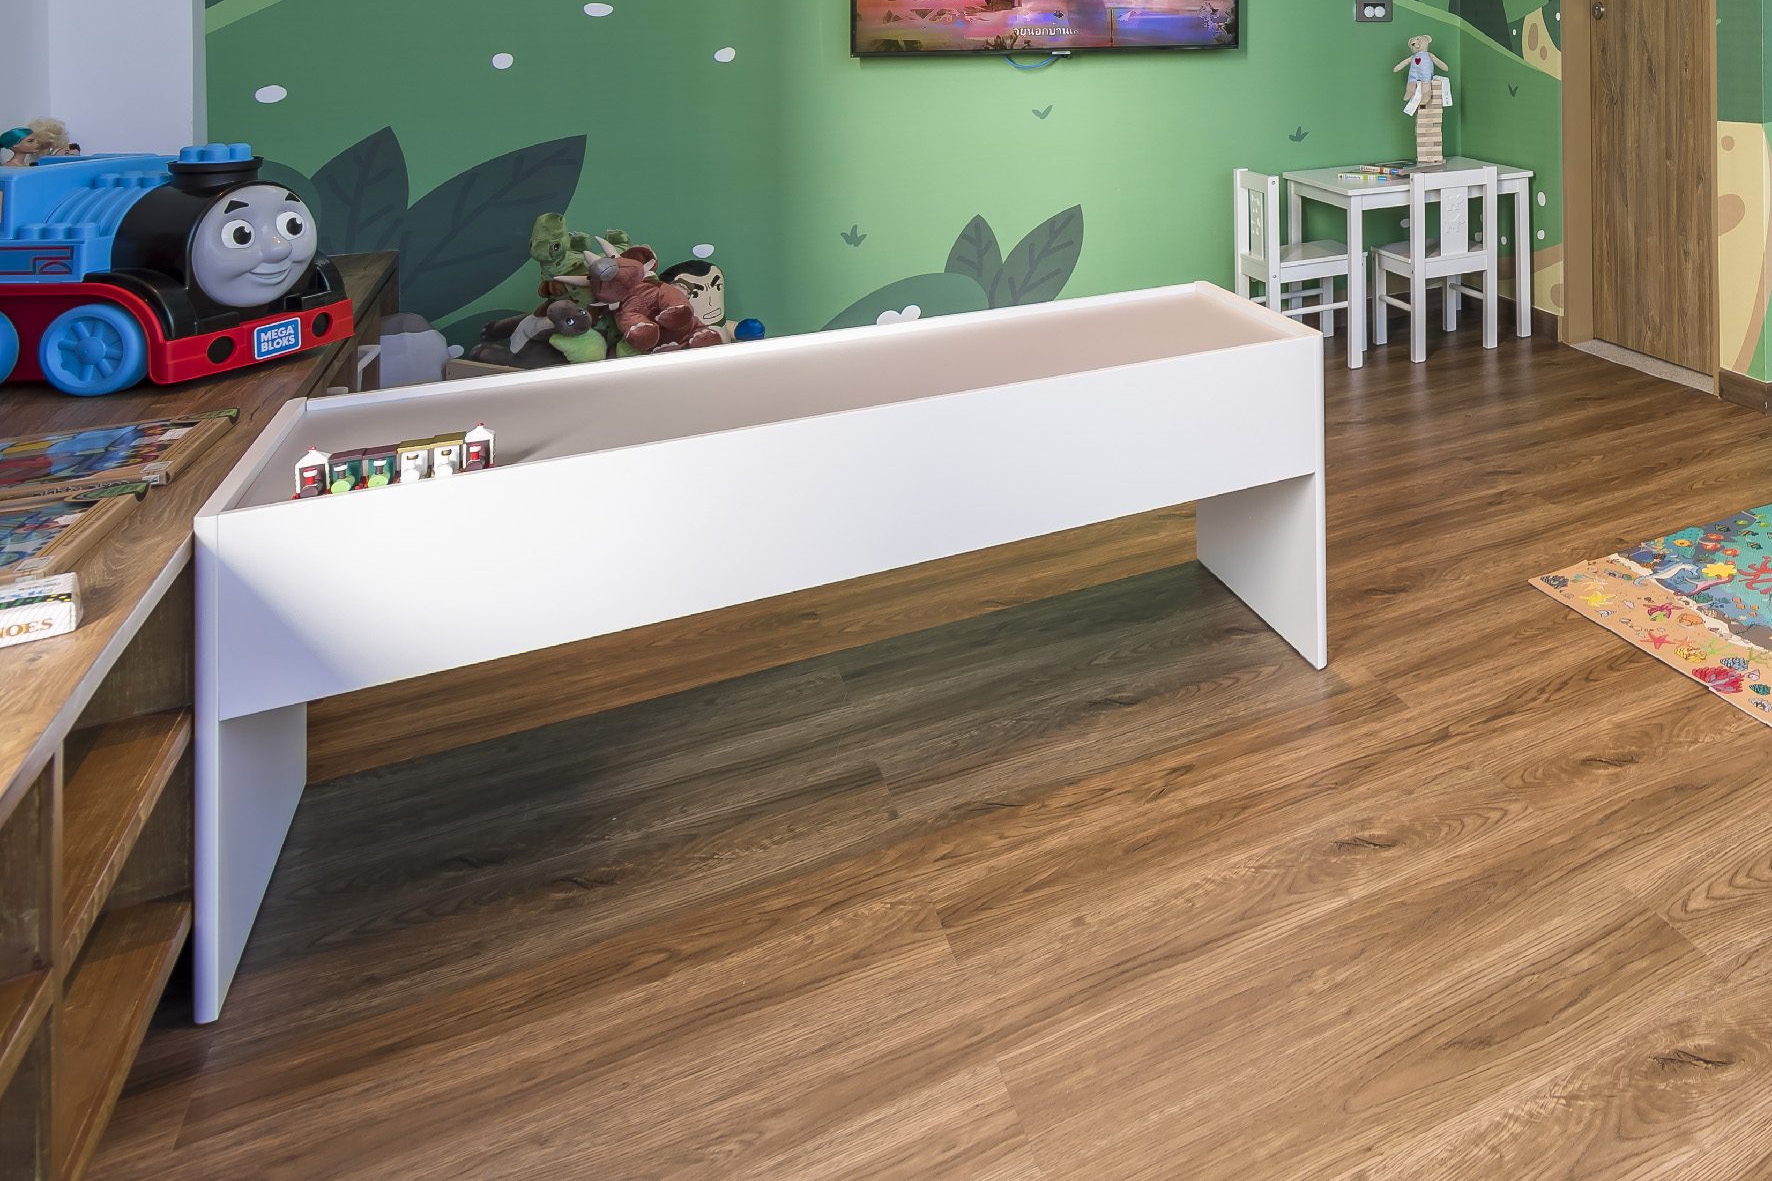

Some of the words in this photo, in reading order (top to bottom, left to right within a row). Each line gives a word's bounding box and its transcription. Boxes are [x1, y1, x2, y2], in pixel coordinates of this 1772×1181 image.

[261, 325, 294, 342] MEGA
[260, 335, 296, 352] BLOKS
[0, 617, 53, 638] OES
